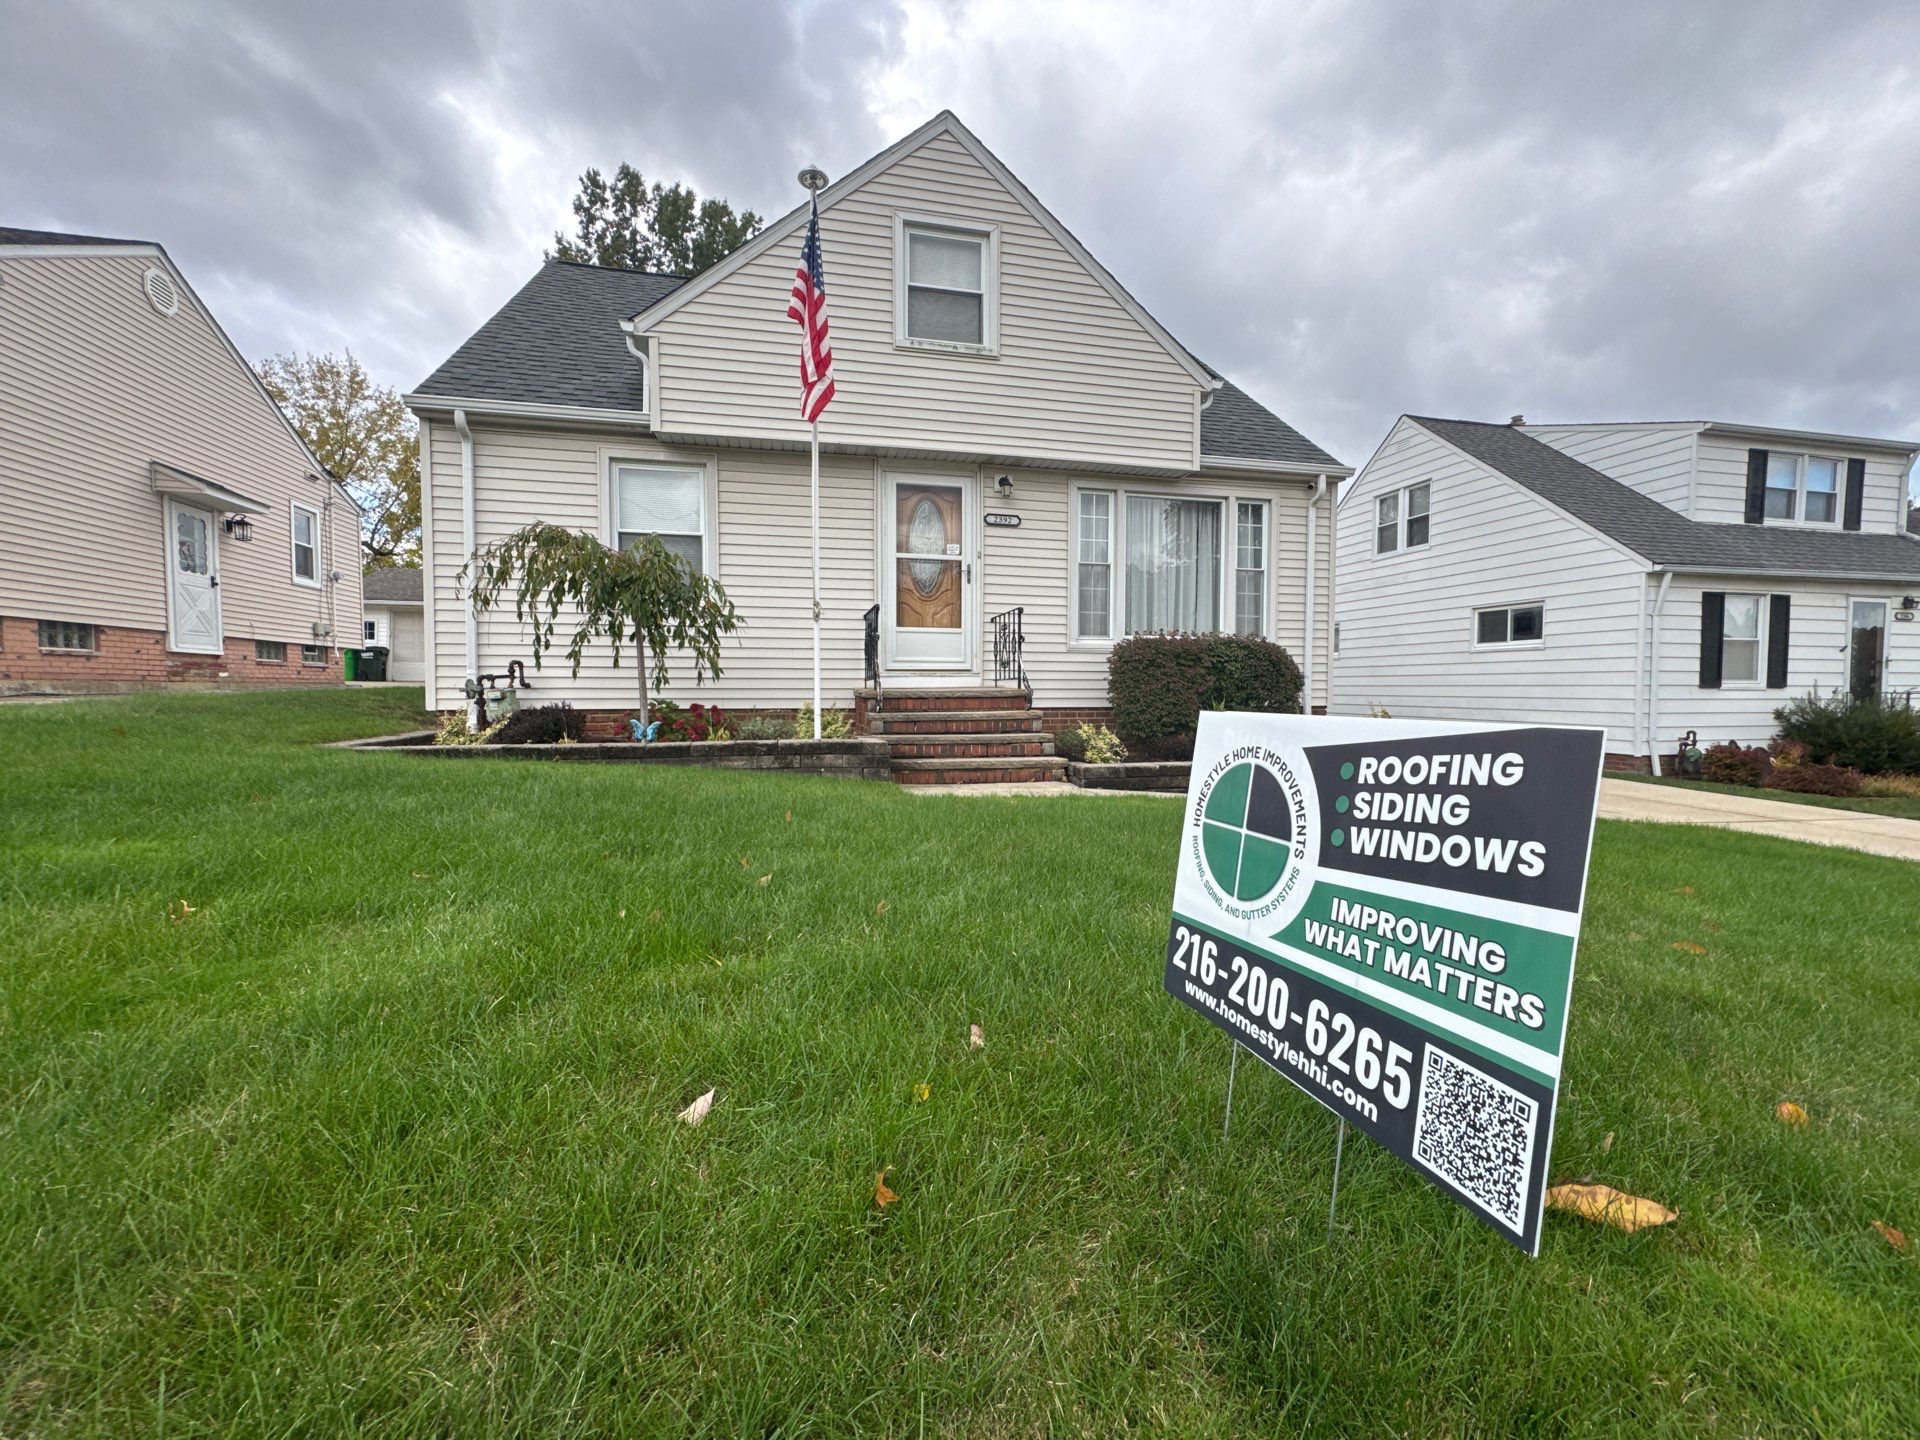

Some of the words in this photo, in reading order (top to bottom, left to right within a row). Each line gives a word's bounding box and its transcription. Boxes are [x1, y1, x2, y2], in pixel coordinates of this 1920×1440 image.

[993, 516, 1012, 524] 2392
[1357, 752, 1525, 787] ROOFING
[1193, 754, 1232, 828] HOMESTYLE
[1232, 746, 1262, 763] HOME
[1262, 748, 1307, 860] IMPROVEMENTS
[1352, 791, 1471, 827] SIDING
[1349, 826, 1547, 878] WINDOWS
[1224, 903, 1241, 919] AND
[1241, 904, 1272, 921] GUTTER
[1270, 866, 1301, 911] SYSTEMS
[1330, 897, 1507, 975] IMPROVING
[1304, 918, 1382, 967] WHAT
[1383, 946, 1547, 1031] MATTERS
[1172, 926, 1415, 1110] 216-200-6265
[1185, 979, 1379, 1124] www.homestylehhi.com
